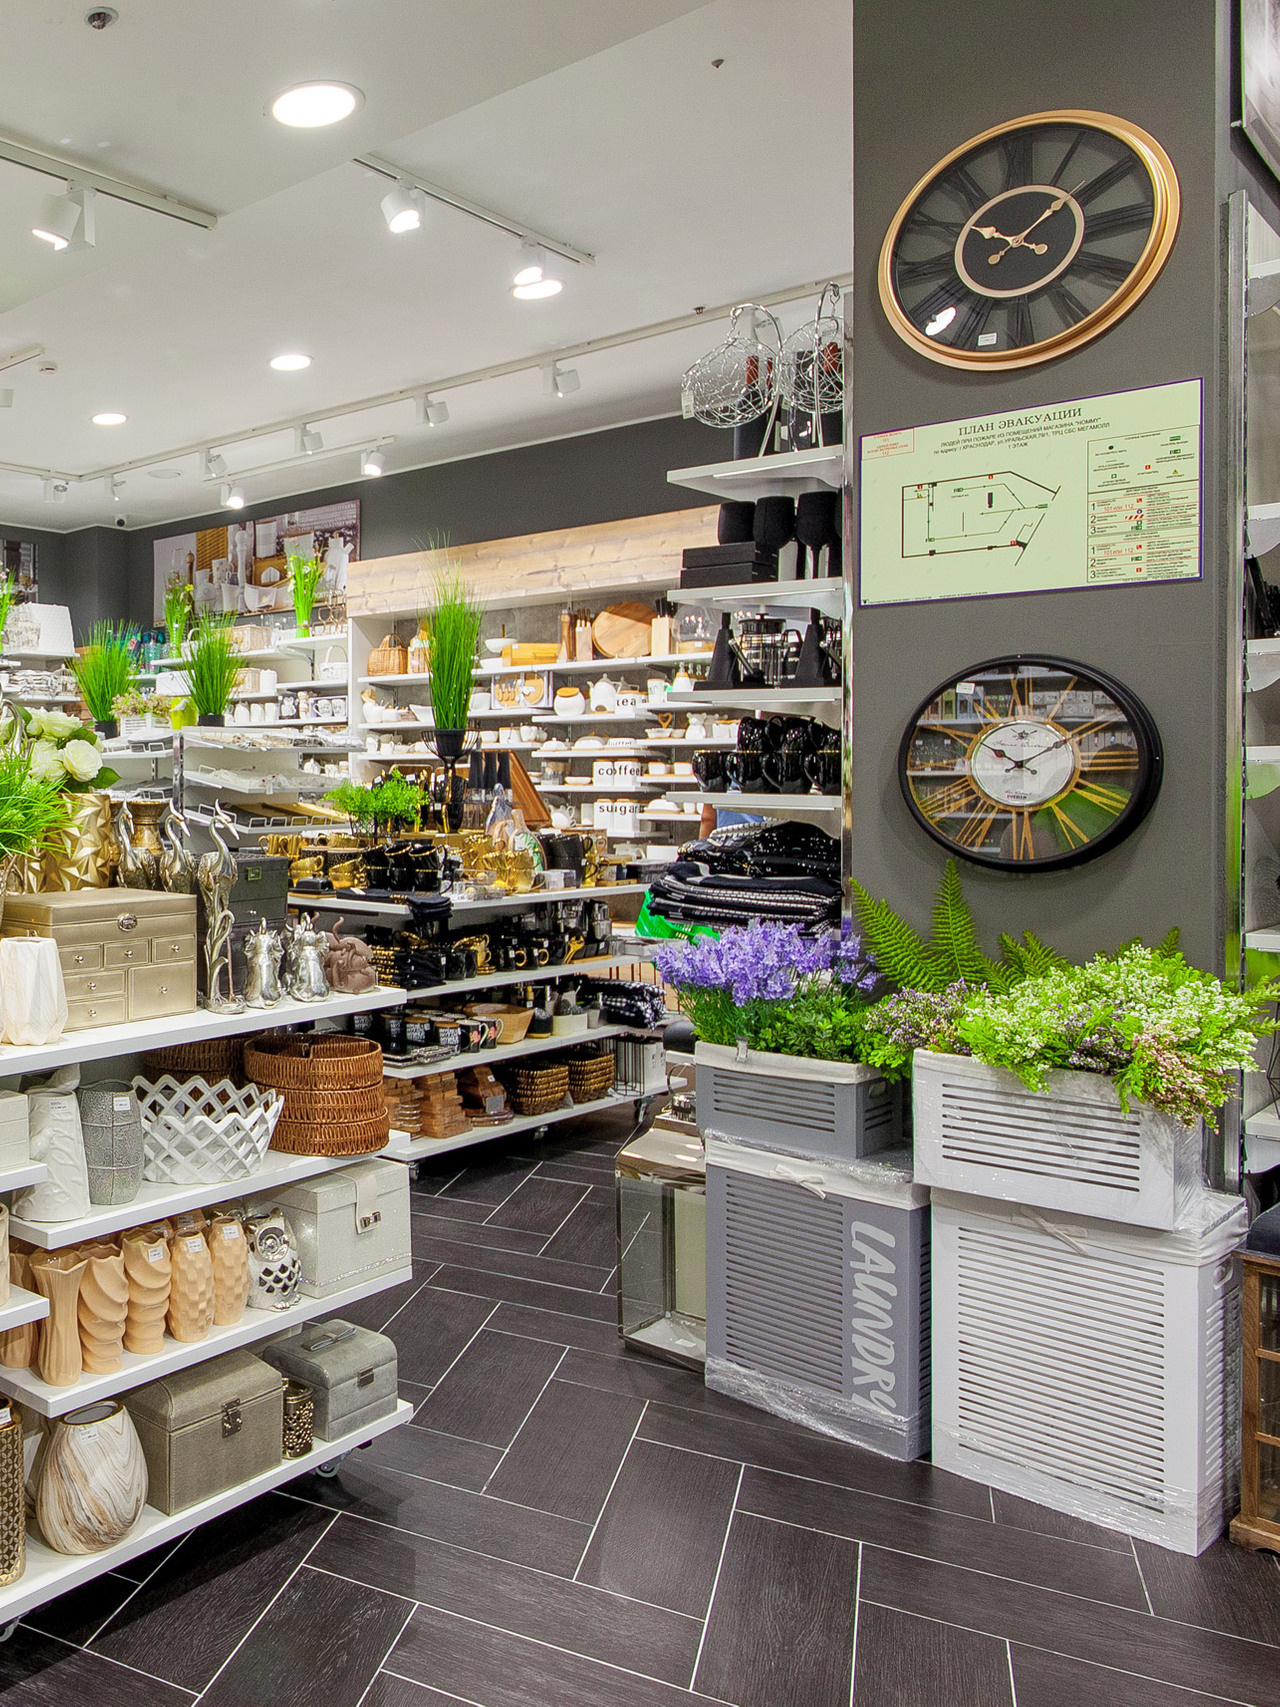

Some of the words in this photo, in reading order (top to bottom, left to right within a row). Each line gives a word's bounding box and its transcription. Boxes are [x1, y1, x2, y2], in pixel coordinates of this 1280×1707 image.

[959, 421, 995, 436] ПЛАН
[998, 407, 1083, 429] ЭВАКУАЦИИ
[973, 433, 996, 443] ПОЖАРЕ
[849, 1220, 898, 1417] LAUNDRY
